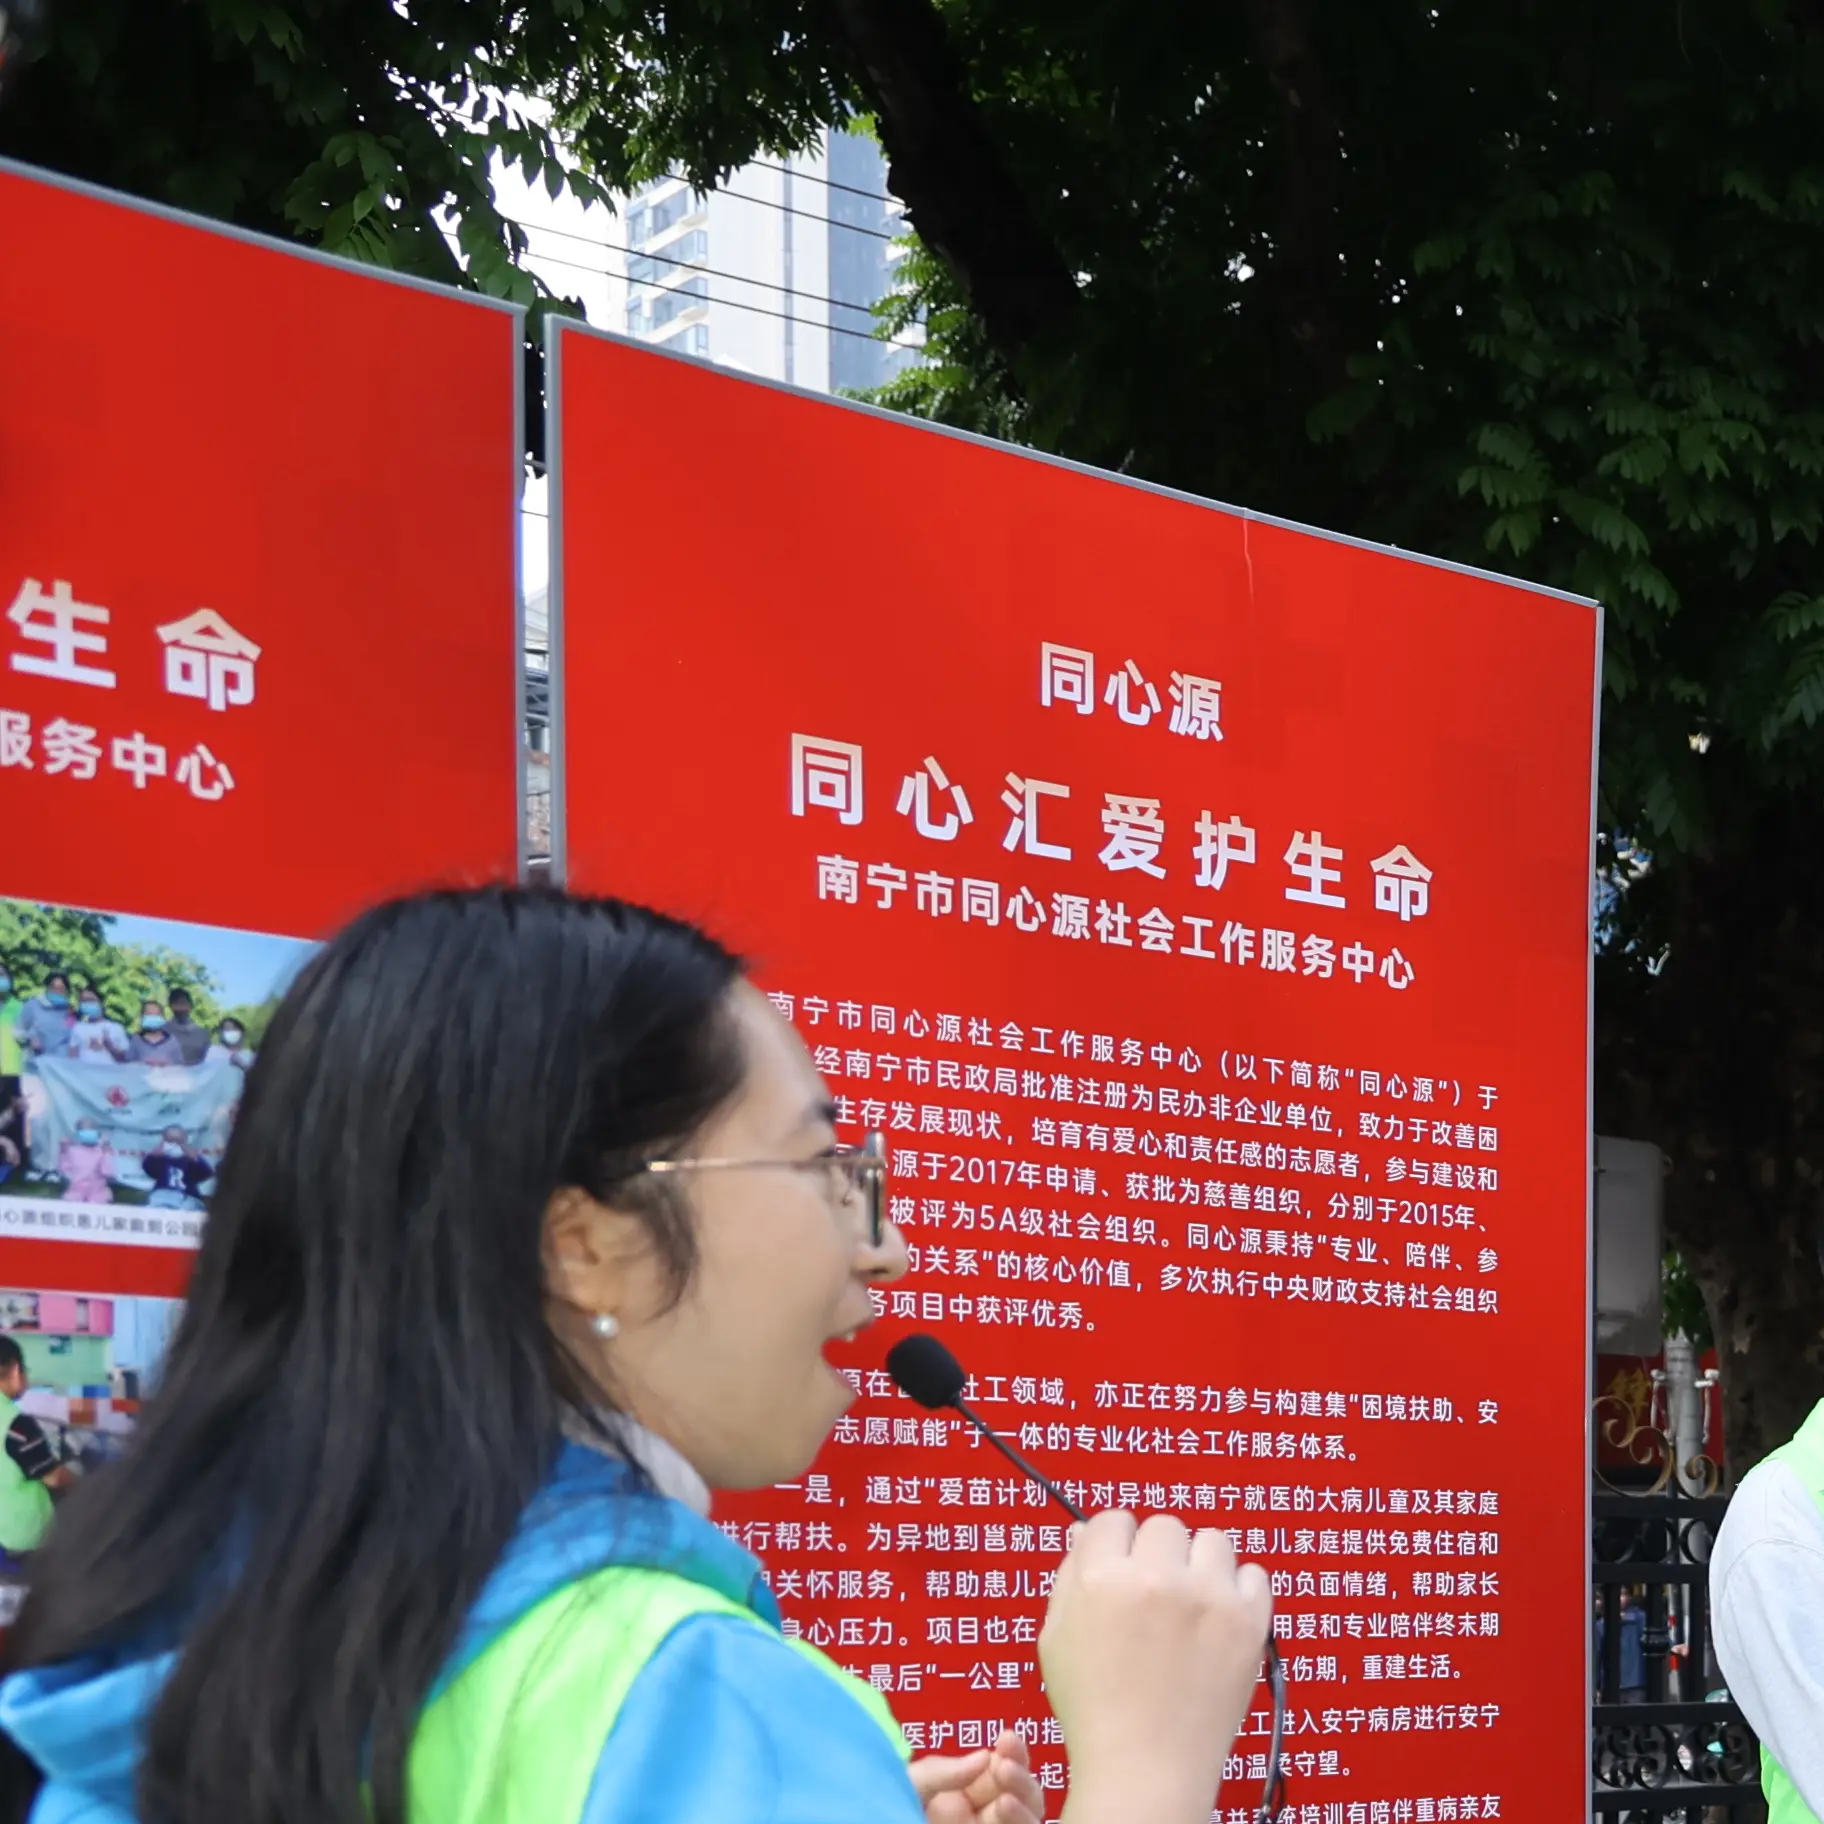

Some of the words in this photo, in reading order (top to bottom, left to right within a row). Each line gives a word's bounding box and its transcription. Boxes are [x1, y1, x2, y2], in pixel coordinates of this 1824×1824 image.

[7, 577, 262, 712] 生命
[1041, 641, 1224, 741] 同心源
[0, 708, 235, 800] 服务中心
[790, 733, 1433, 921] 同心汇爱护生命
[817, 854, 1415, 990] 南宁市同心源社会工作服务中心
[835, 1144, 1487, 1232] 源于2017年申请、获批为慈善组织，分别于2015年、
[837, 1368, 1498, 1424] 源在社工领域，亦正在努力参与构建集“困境扶助、安
[761, 1569, 1057, 1601] 关怀服务，帮助患儿改
[1271, 1571, 1498, 1599] 的负面情绪，帮助家长
[1273, 1613, 1498, 1640] 用爱和专业陪伴终末期
